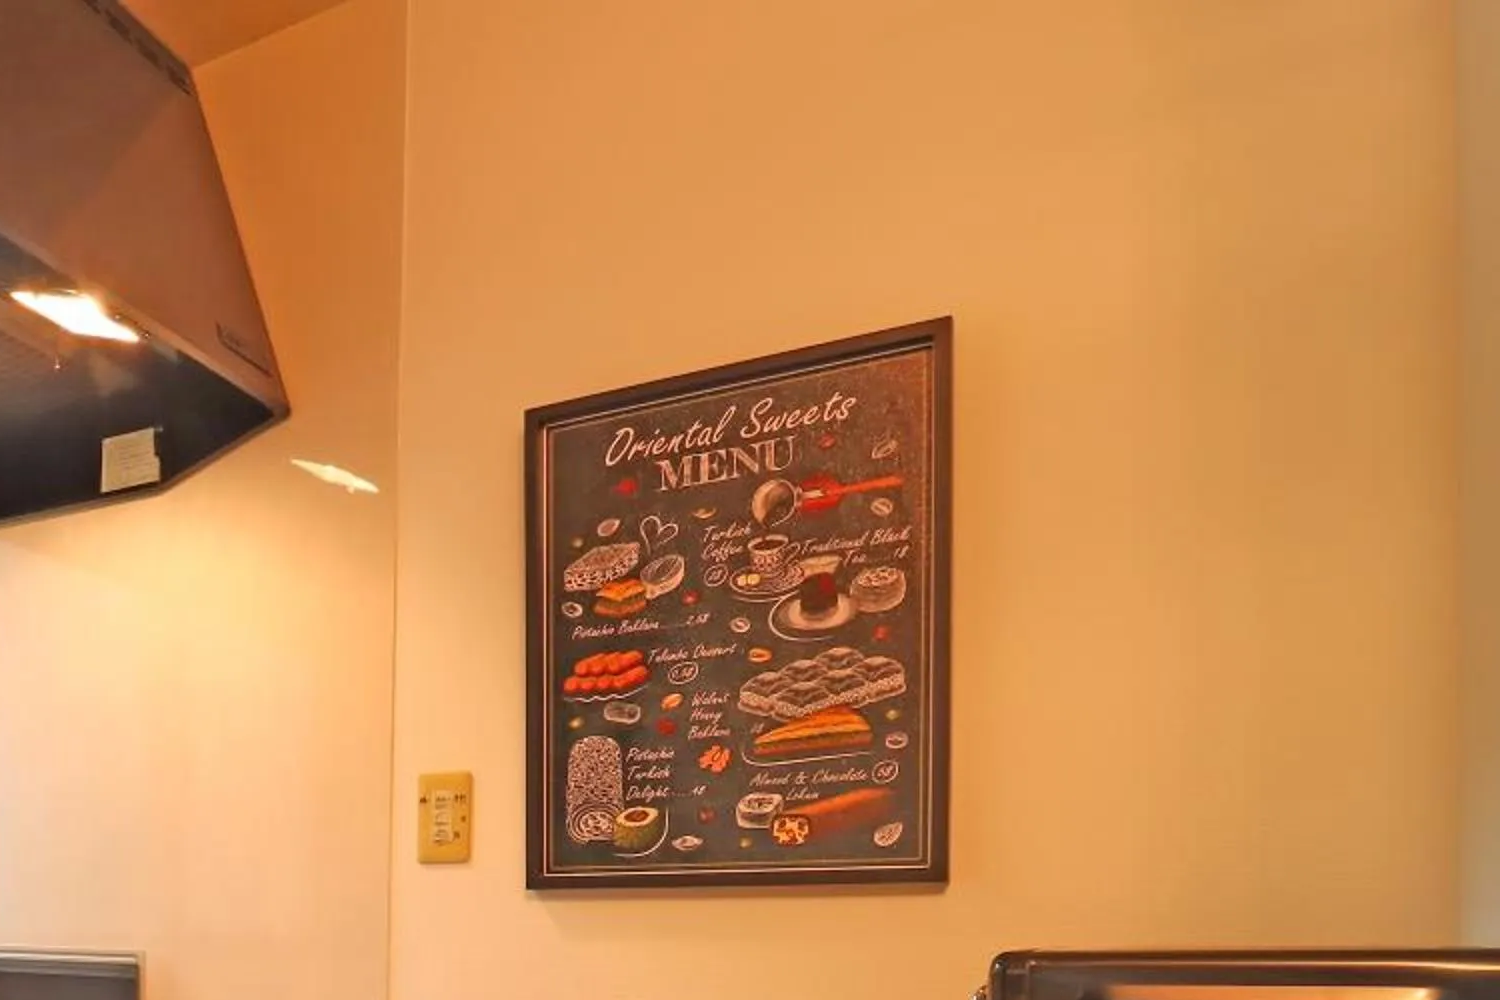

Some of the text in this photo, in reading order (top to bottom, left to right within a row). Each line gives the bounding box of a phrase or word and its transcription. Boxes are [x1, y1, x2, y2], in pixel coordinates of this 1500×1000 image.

[604, 391, 858, 467] Oriental Sweets
[656, 434, 798, 492] MENU
[700, 540, 744, 563] Coffee
[625, 784, 670, 803] Delight
